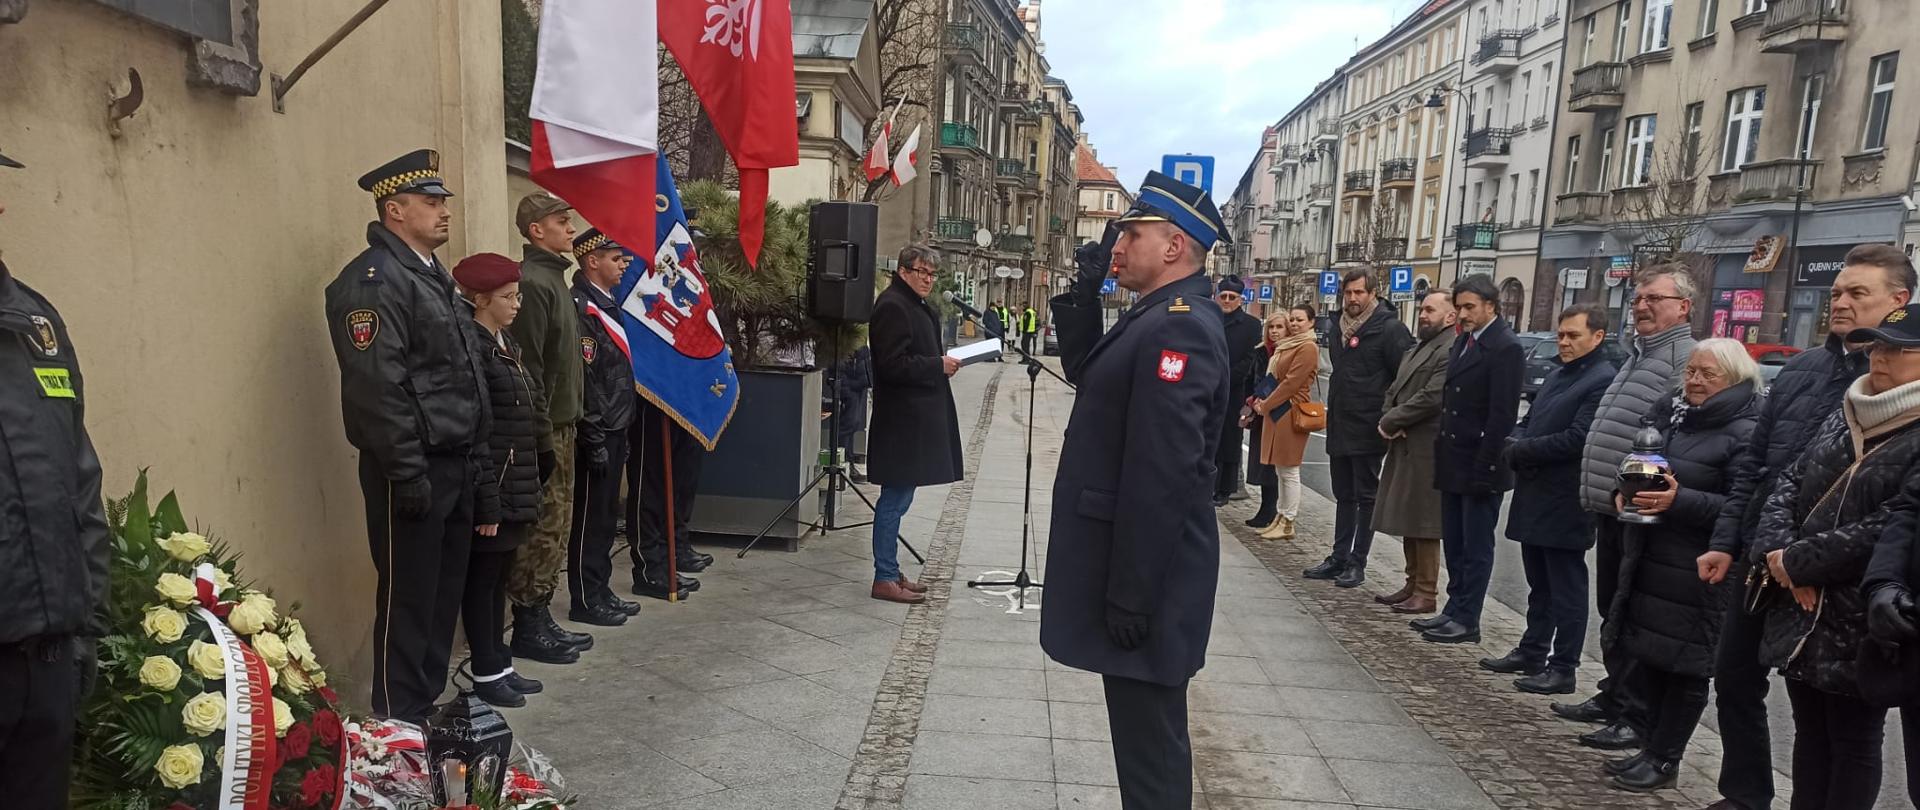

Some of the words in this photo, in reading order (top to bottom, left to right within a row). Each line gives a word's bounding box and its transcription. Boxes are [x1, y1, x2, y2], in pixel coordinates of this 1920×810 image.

[1174, 162, 1204, 190] P
[1832, 262, 1846, 271] SHO
[1324, 274, 1335, 287] P
[1395, 270, 1408, 289] P
[1262, 286, 1271, 297] P
[218, 622, 265, 715] SPOŁECZNE
[229, 723, 266, 805] POLITYKI
